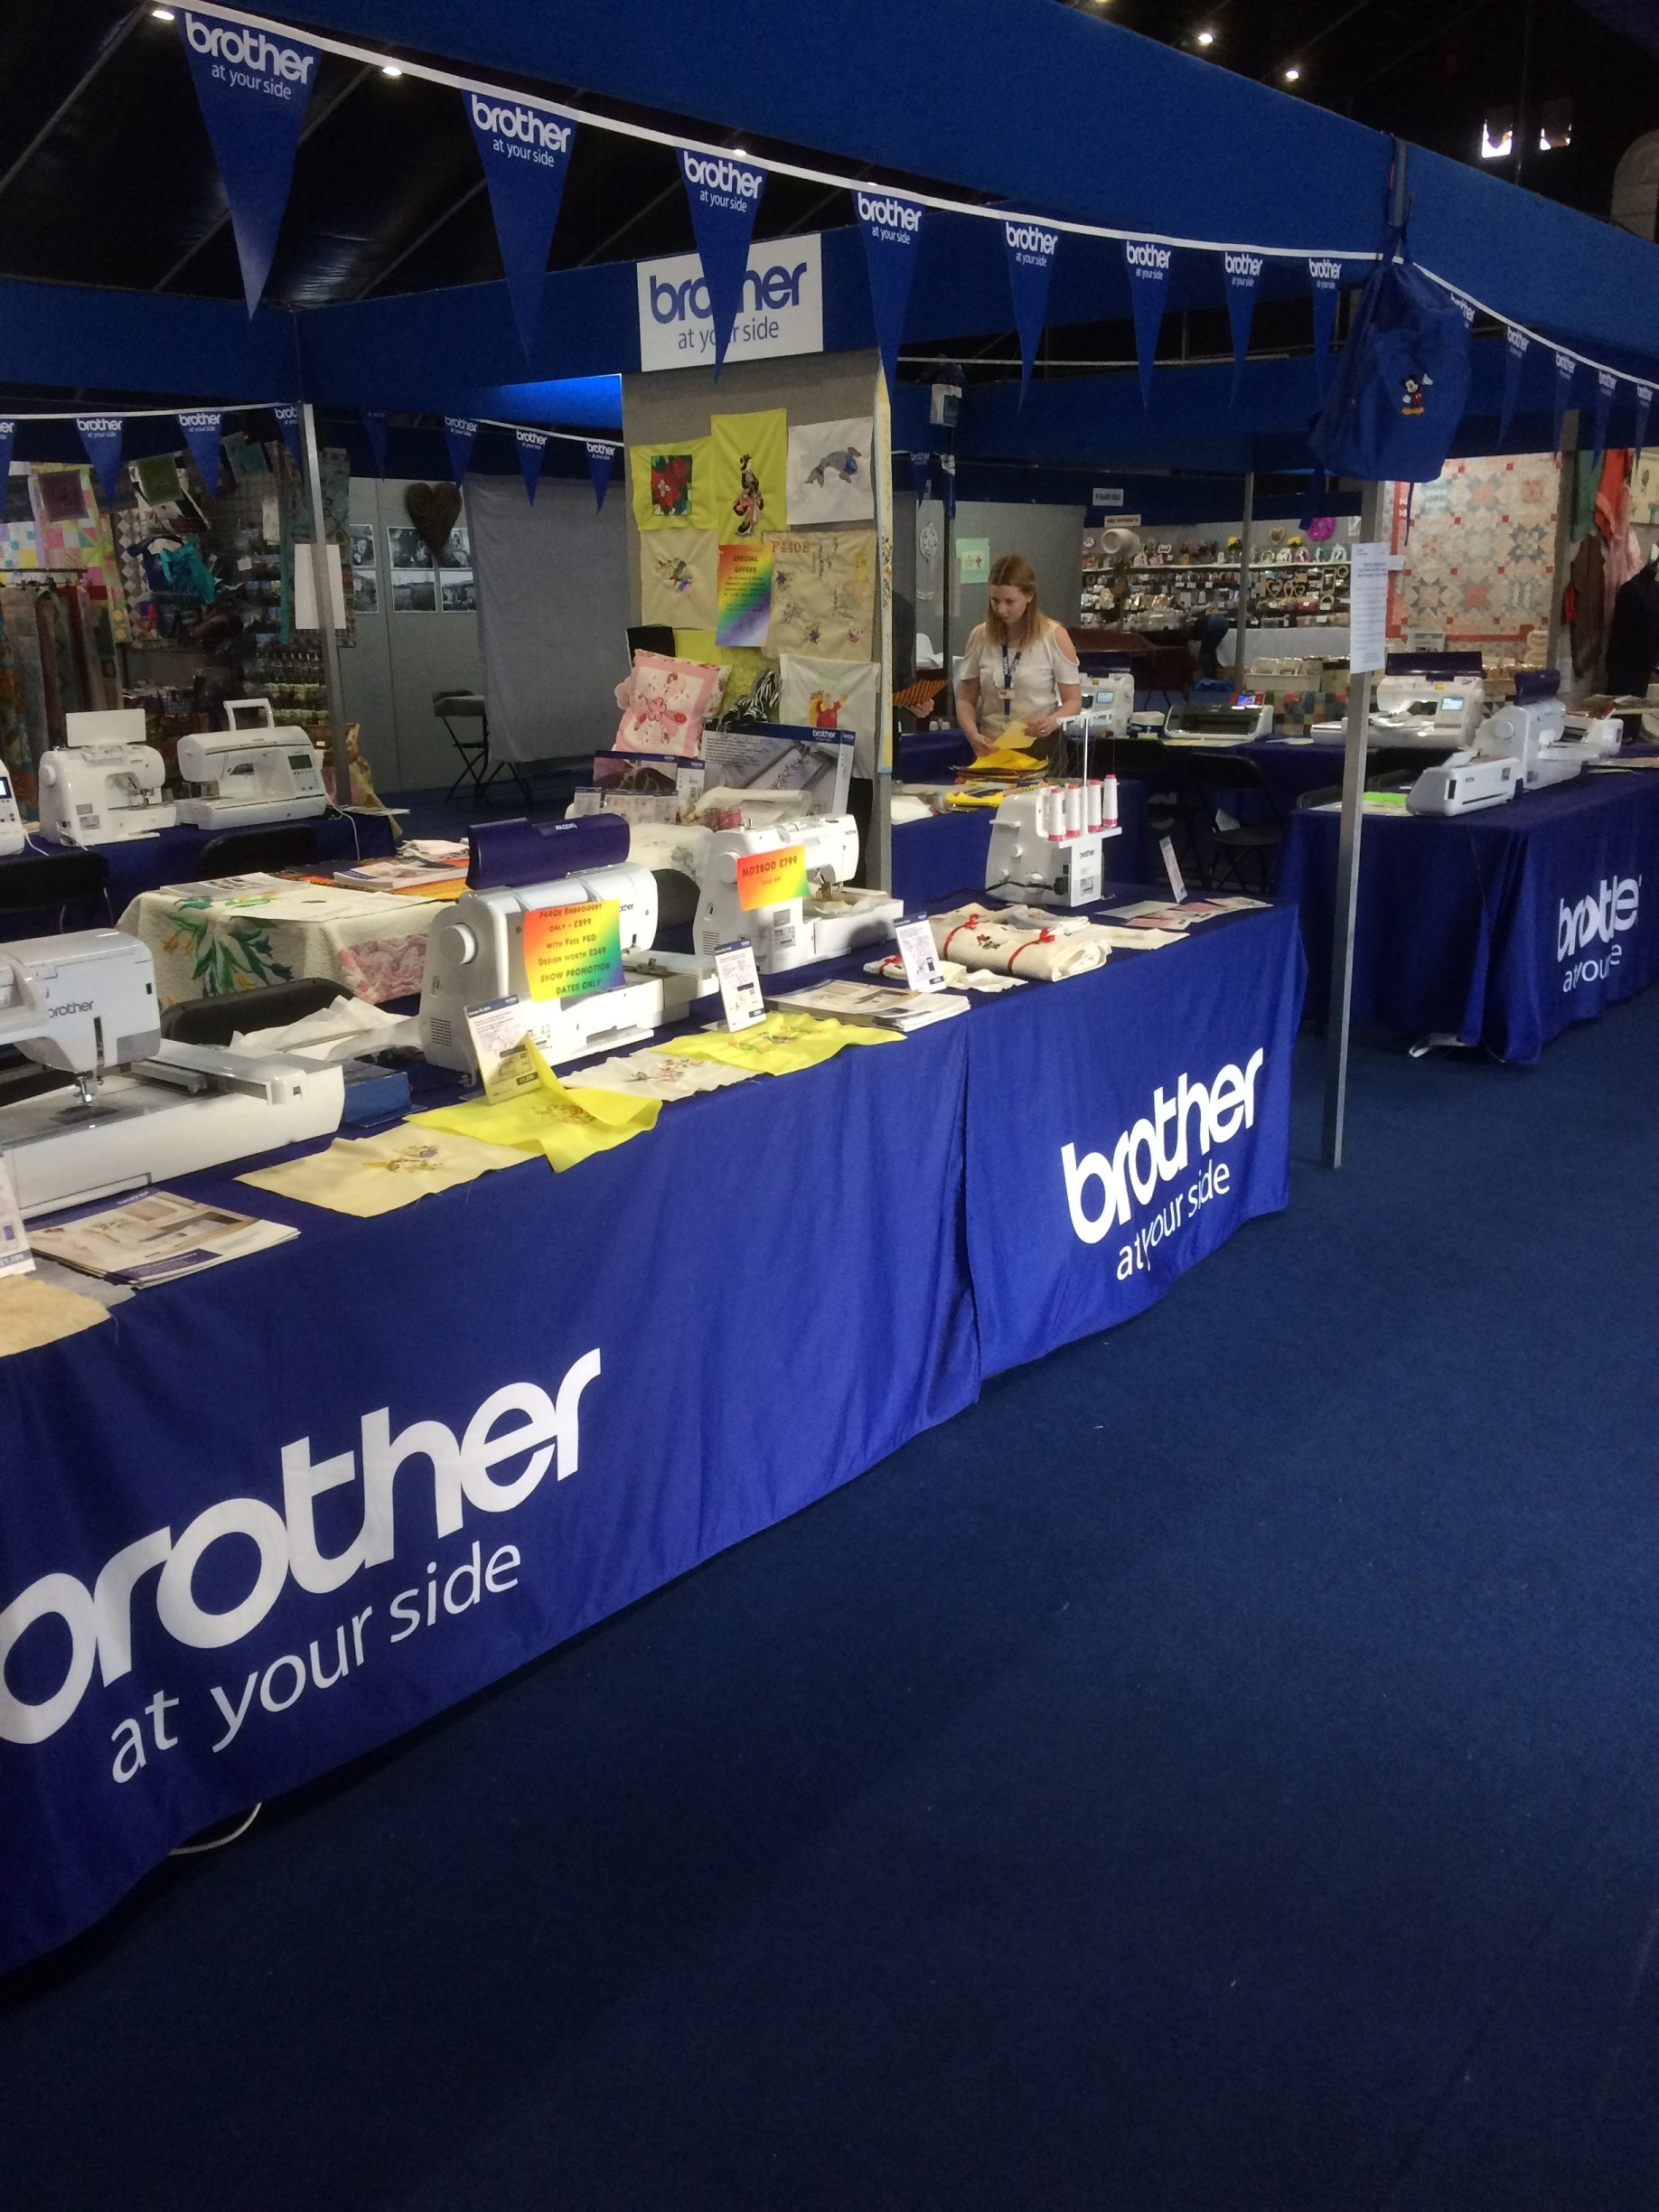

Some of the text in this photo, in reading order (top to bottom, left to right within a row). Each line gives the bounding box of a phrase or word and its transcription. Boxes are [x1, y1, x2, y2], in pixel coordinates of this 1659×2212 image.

[185, 12, 314, 84] brother
[211, 64, 292, 99] at your side
[472, 94, 571, 153] brother
[492, 139, 555, 167] at your side
[684, 151, 762, 199] brother
[699, 190, 747, 212] at your side
[858, 192, 922, 231] brother
[872, 225, 911, 244] at your side
[1006, 221, 1058, 255] brother
[1127, 240, 1171, 268] brother
[1225, 252, 1262, 276] brother
[1308, 258, 1342, 279] brother
[650, 262, 807, 324] broher
[679, 316, 779, 353] at yor side
[76, 418, 122, 431] brother
[179, 413, 220, 426] brother
[445, 416, 477, 432] brother
[516, 429, 547, 445] brother
[586, 442, 614, 455] brother
[812, 729, 836, 738] brother
[549, 923, 567, 933] ONLY
[574, 918, 592, 928] £899
[540, 962, 611, 982] SHOW PROMOTION
[556, 979, 601, 995] DATES ONLY
[1060, 1046, 1263, 1244] brother
[1117, 1158, 1230, 1280] at your side
[111, 1541, 521, 1784] at your side
